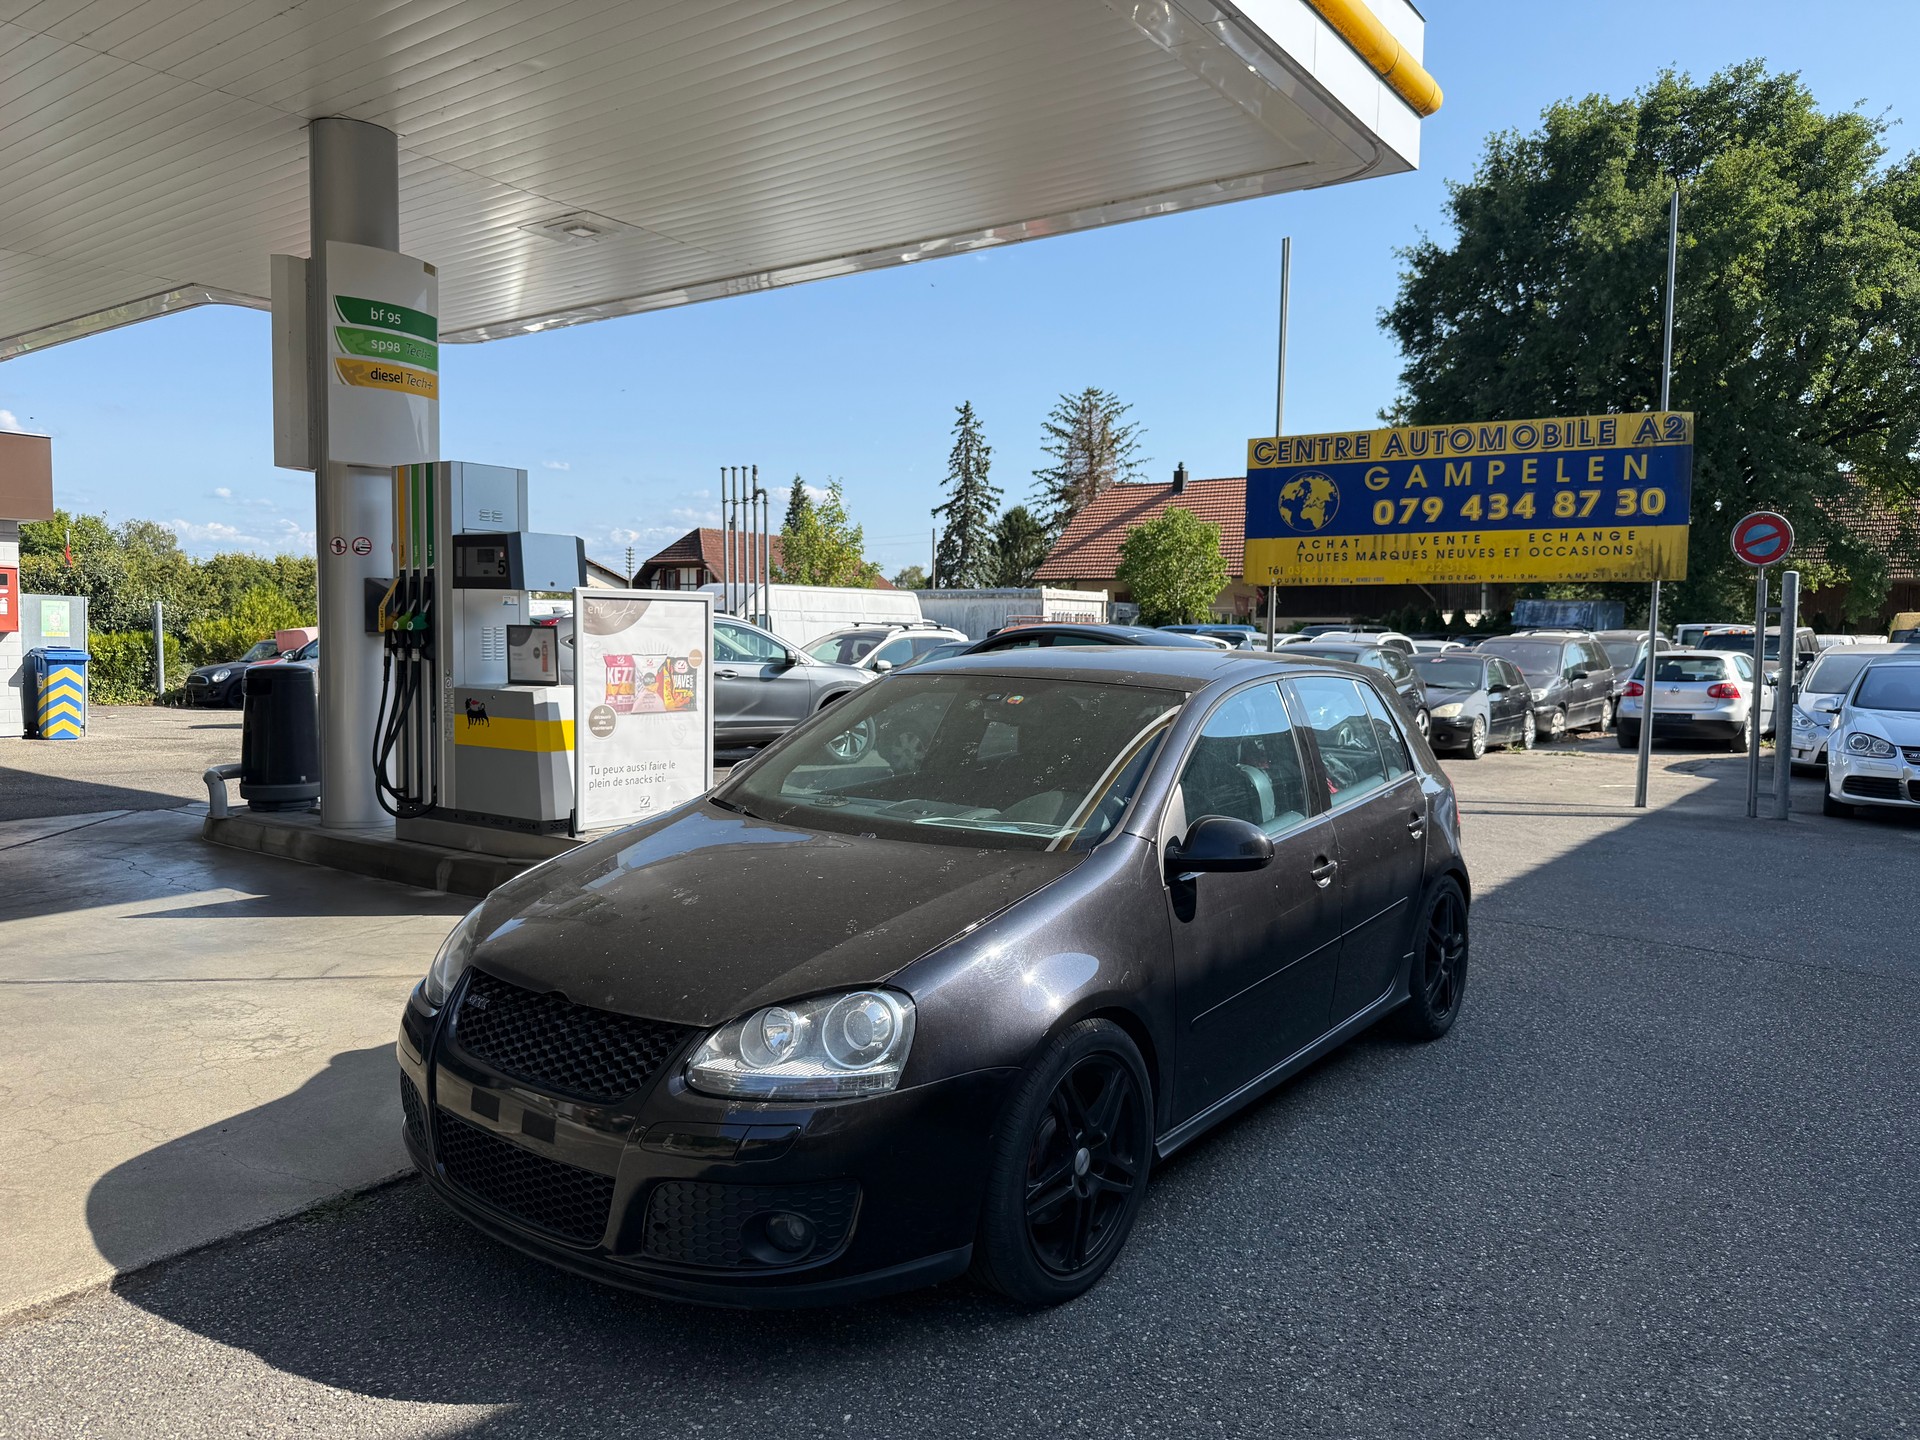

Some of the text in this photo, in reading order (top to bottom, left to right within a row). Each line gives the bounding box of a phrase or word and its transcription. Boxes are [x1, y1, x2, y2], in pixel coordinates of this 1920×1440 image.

[370, 307, 401, 325] bf 95
[371, 339, 401, 353] sp98
[370, 367, 433, 390] diesel Tech+
[1252, 414, 1687, 465] CENTRE AUTOMOBILE A2
[1364, 454, 1648, 491] GAMPELEN
[1372, 487, 1667, 526] 079 434 87 30
[1298, 530, 1635, 550] ACHAT VENTE ECHANGE
[1297, 545, 1633, 563] TOUTES MARQUES NEUVES ET OCCASIONS
[498, 560, 506, 575] 5
[1268, 566, 1283, 575] Tél
[1287, 565, 1308, 575] 032
[587, 603, 604, 615] eni
[589, 760, 676, 776] Tu peux aussi faire le
[589, 773, 667, 790] plein de snacks ici.
